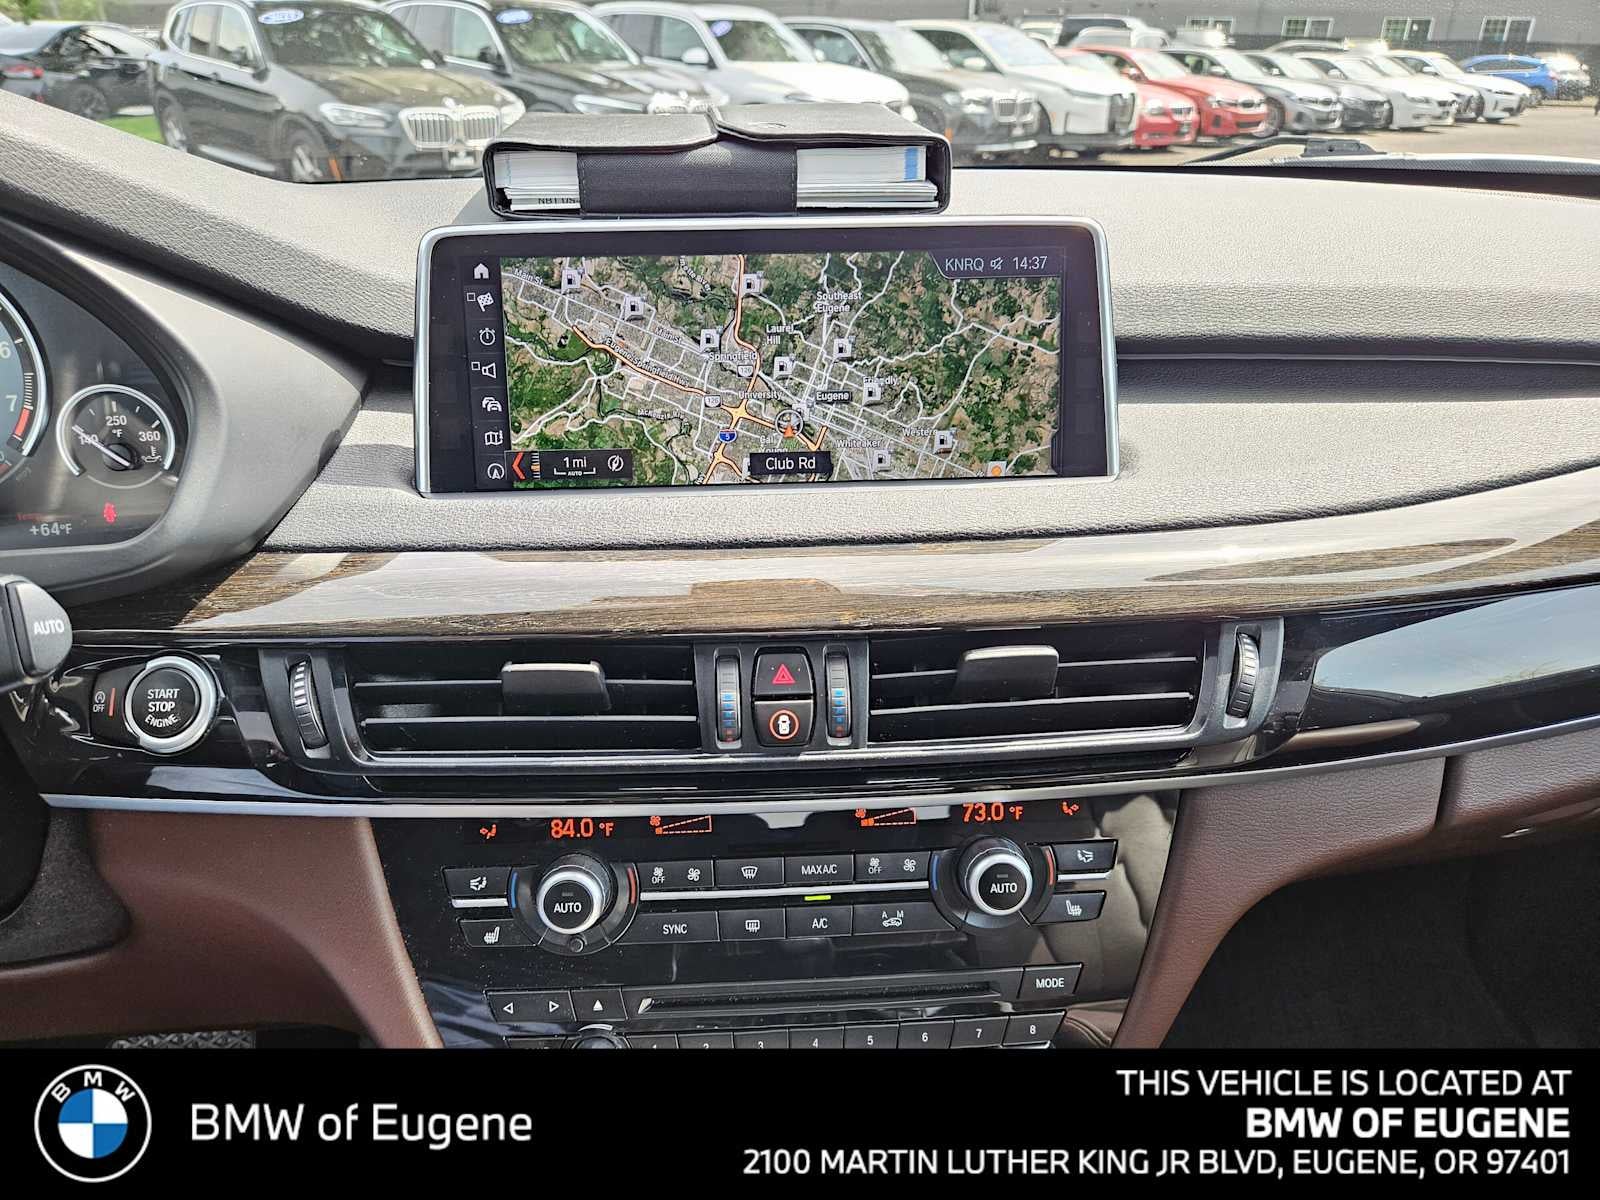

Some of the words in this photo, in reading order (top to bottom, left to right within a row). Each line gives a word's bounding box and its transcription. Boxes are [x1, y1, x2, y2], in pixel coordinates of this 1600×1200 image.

[945, 258, 984, 272] KNRQ
[1013, 256, 1048, 269] 14:37
[515, 269, 533, 282] Main
[817, 292, 862, 300] Southeast
[817, 304, 850, 313] Eugene
[766, 324, 794, 333] Laurel
[767, 336, 781, 345] Hill
[709, 352, 757, 362] Springfield
[738, 391, 782, 400] University
[816, 392, 849, 402] Eugene
[6, 395, 18, 412] 7
[106, 416, 127, 426] 250
[138, 431, 161, 442] 360
[563, 457, 569, 468] 1
[572, 457, 587, 468] mi
[765, 457, 795, 470] Club
[798, 456, 816, 469] Rd
[34, 620, 65, 635] AUTO
[147, 688, 180, 700] START
[93, 704, 105, 712] OFF
[148, 701, 176, 712] STOP
[145, 713, 179, 728] ENGINE
[962, 802, 1005, 822] 73.0
[551, 818, 594, 838] 84.0
[801, 865, 822, 875] MAX
[823, 864, 838, 874] A/C
[868, 866, 882, 874] OFF
[652, 876, 665, 884] OFF
[990, 882, 1018, 894] AUTO
[553, 902, 582, 913] AUTO
[662, 923, 688, 935] SYNC
[812, 918, 828, 929] A/C
[1036, 977, 1065, 988] MODE
[976, 1029, 982, 1038] 7
[1030, 1025, 1036, 1035] 8
[867, 1035, 874, 1045] 5
[922, 1032, 929, 1042] 6
[812, 1038, 819, 1048] 4
